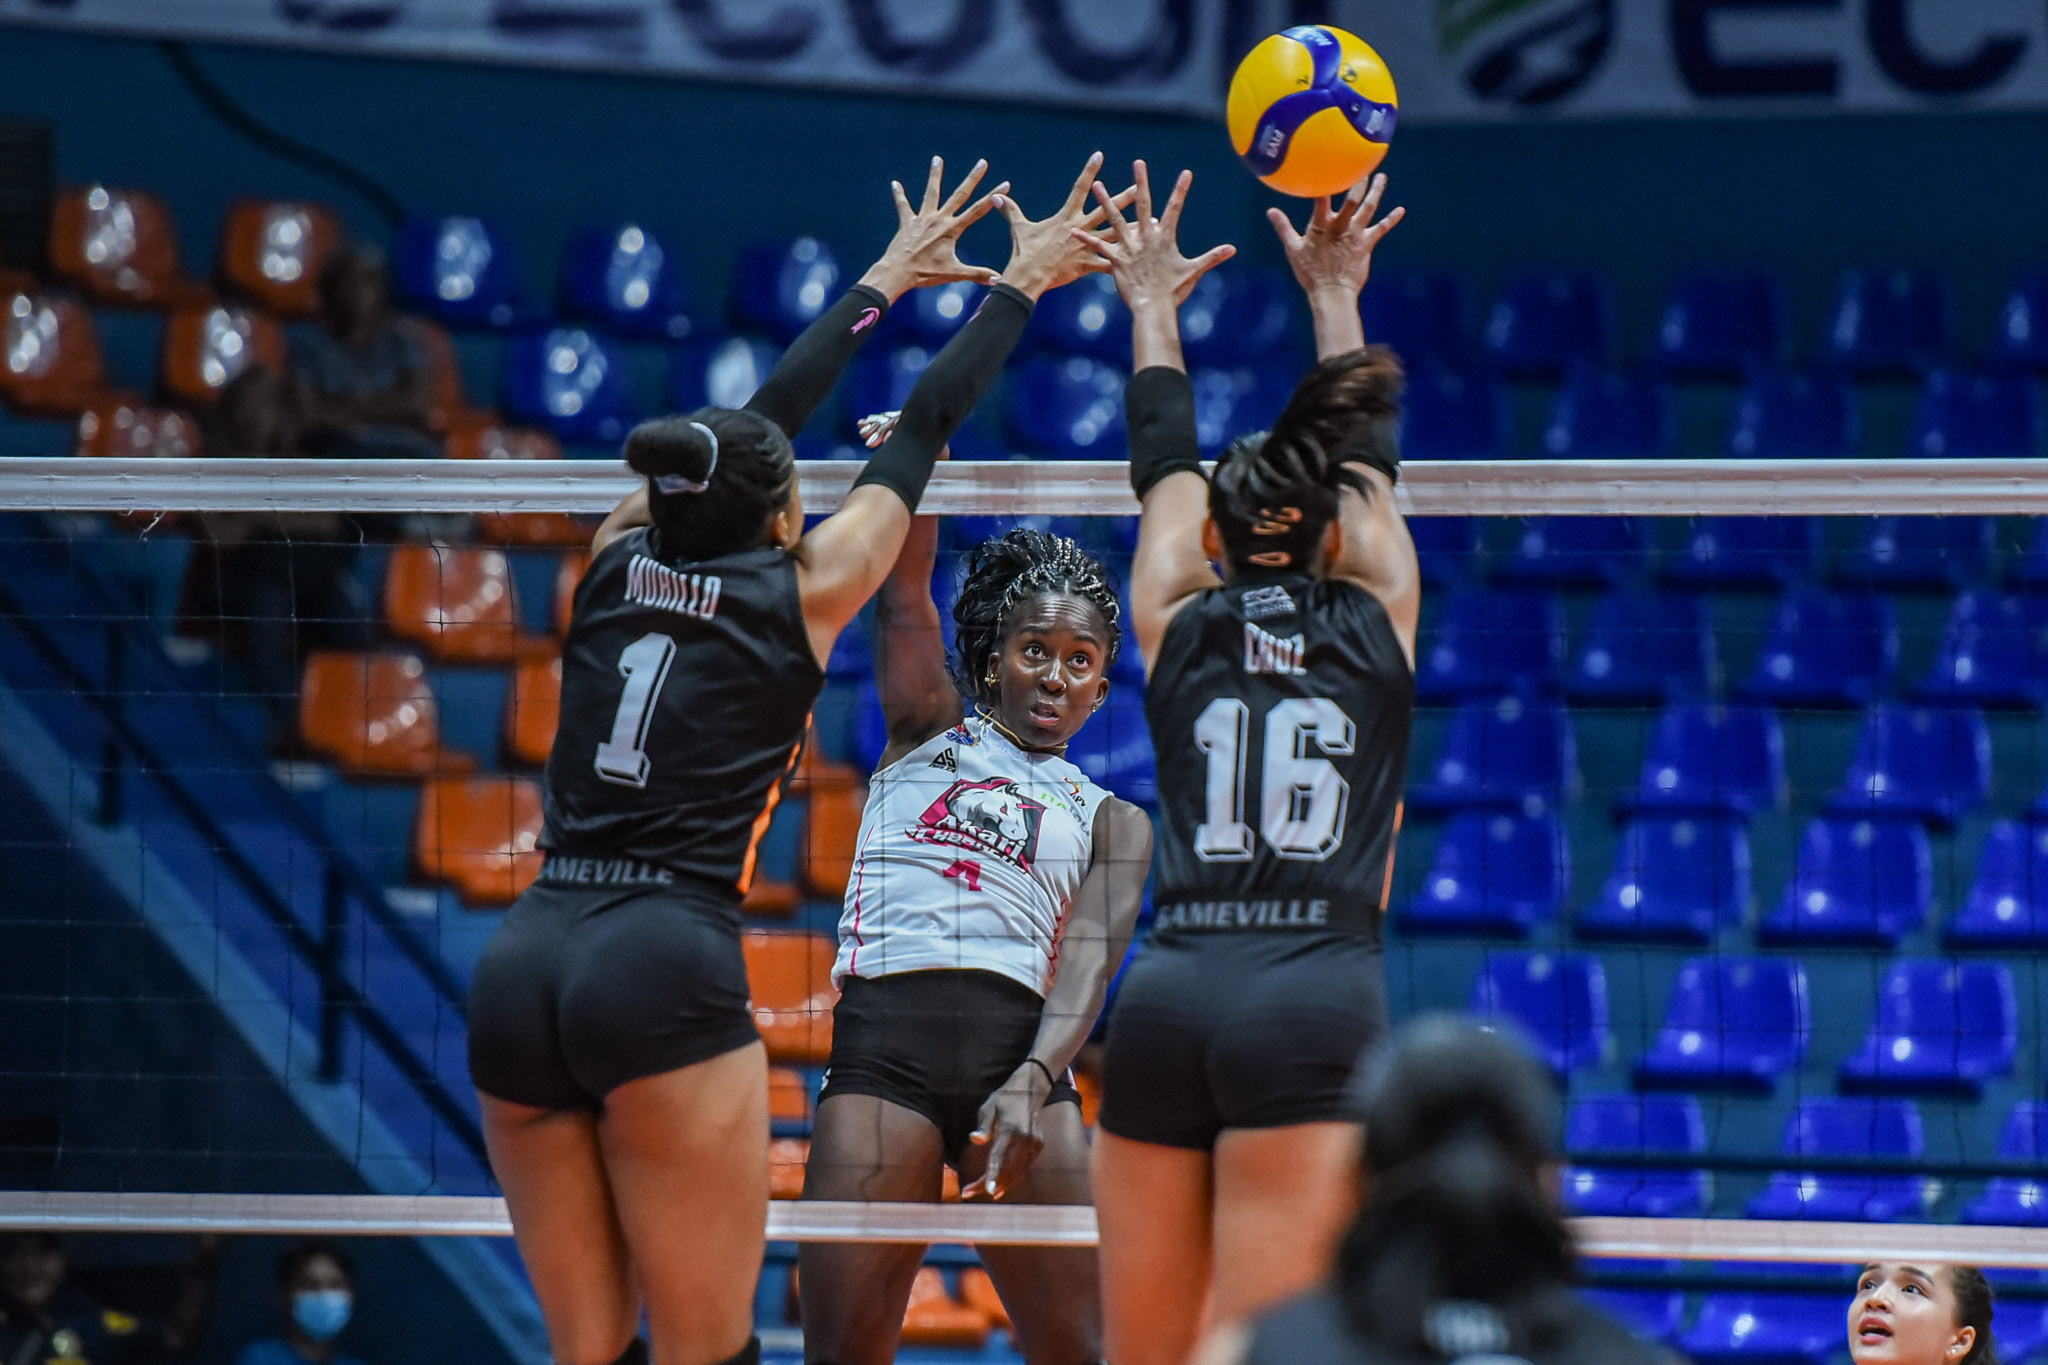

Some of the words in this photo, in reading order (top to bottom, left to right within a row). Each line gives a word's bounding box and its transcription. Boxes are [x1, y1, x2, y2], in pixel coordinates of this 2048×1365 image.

[1243, 621, 1307, 676] CRUZ
[594, 632, 677, 789] 1
[1193, 697, 1357, 862] 16
[538, 856, 675, 885] AMEVILLE
